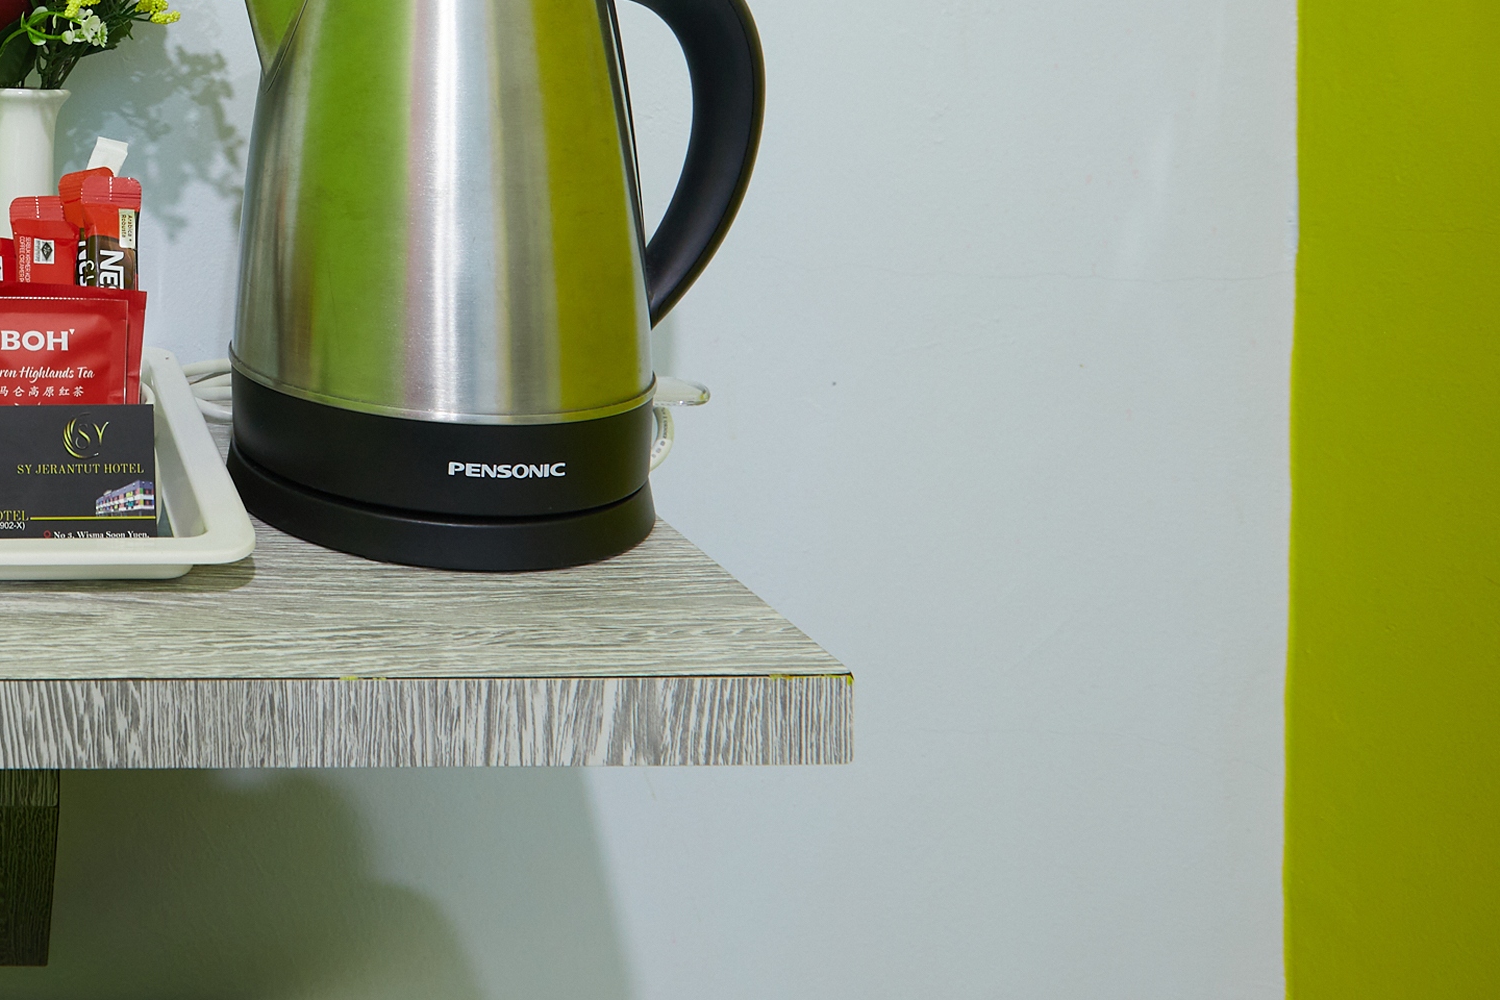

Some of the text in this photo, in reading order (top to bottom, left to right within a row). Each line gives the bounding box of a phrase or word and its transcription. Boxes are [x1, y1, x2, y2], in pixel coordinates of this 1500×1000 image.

[99, 249, 125, 290] NE
[0, 330, 69, 351] BOH
[17, 365, 75, 383] Highlands
[77, 366, 95, 378] Tea
[17, 463, 145, 475] SY JERANTUT HOTEL
[447, 461, 566, 479] PENSONIC
[77, 531, 104, 539] Wisma
[105, 531, 123, 539] Soon
